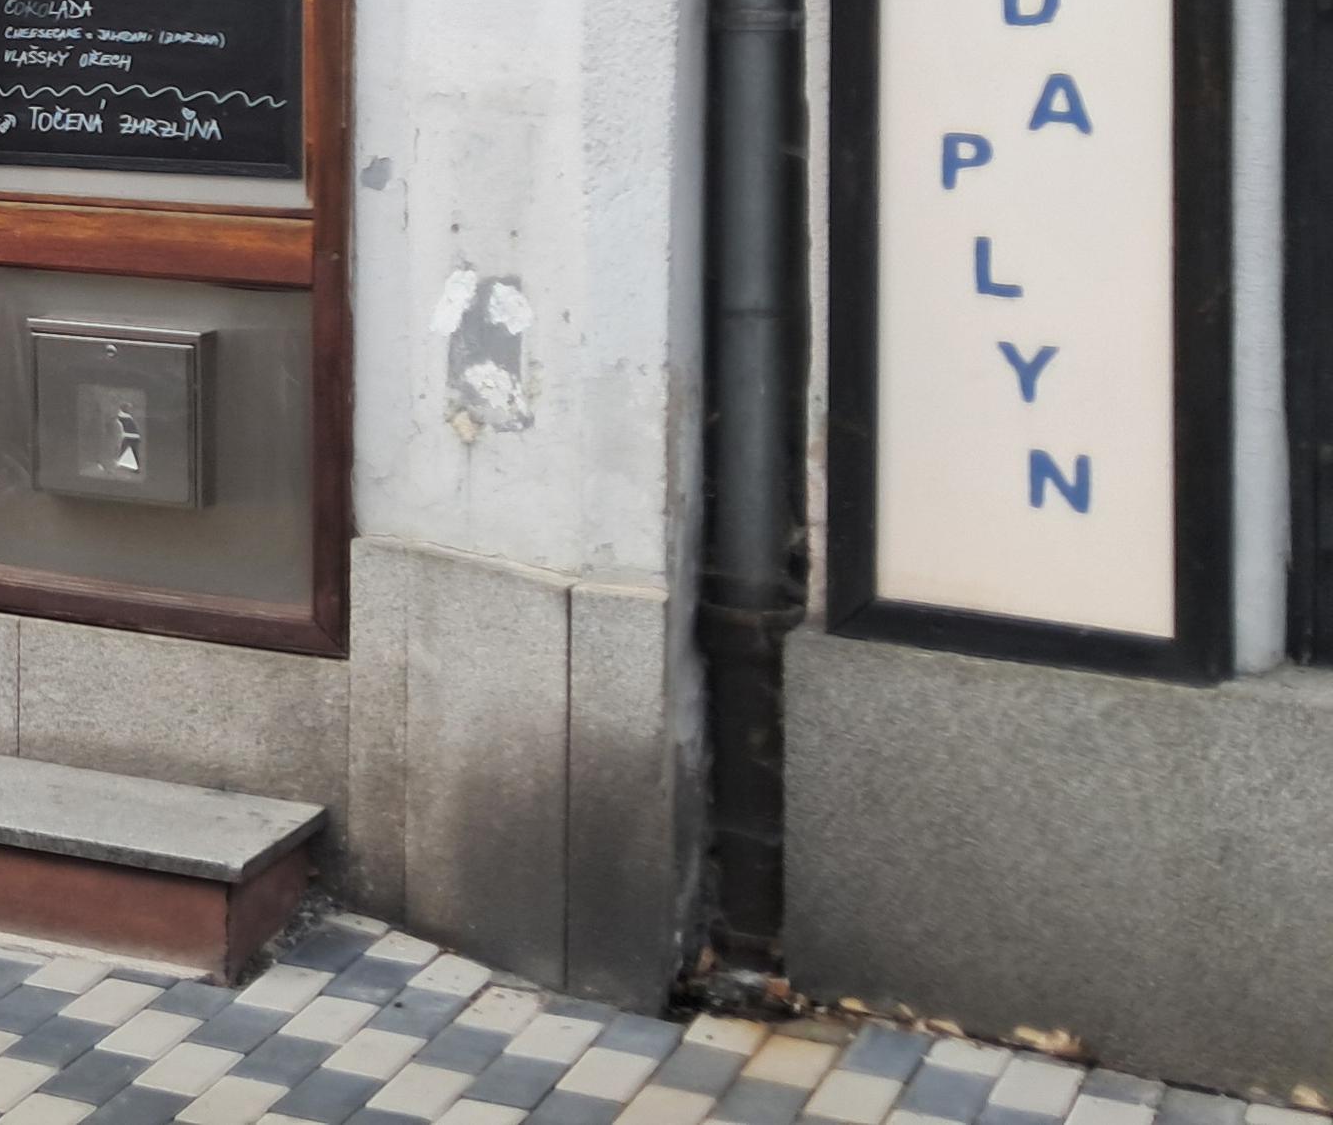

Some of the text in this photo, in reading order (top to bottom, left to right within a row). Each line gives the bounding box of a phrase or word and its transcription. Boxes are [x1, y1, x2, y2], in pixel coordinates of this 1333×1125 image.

[28, 98, 222, 141] TOČENÁ ZMRZLINA
[941, 132, 1093, 514] PLYN
